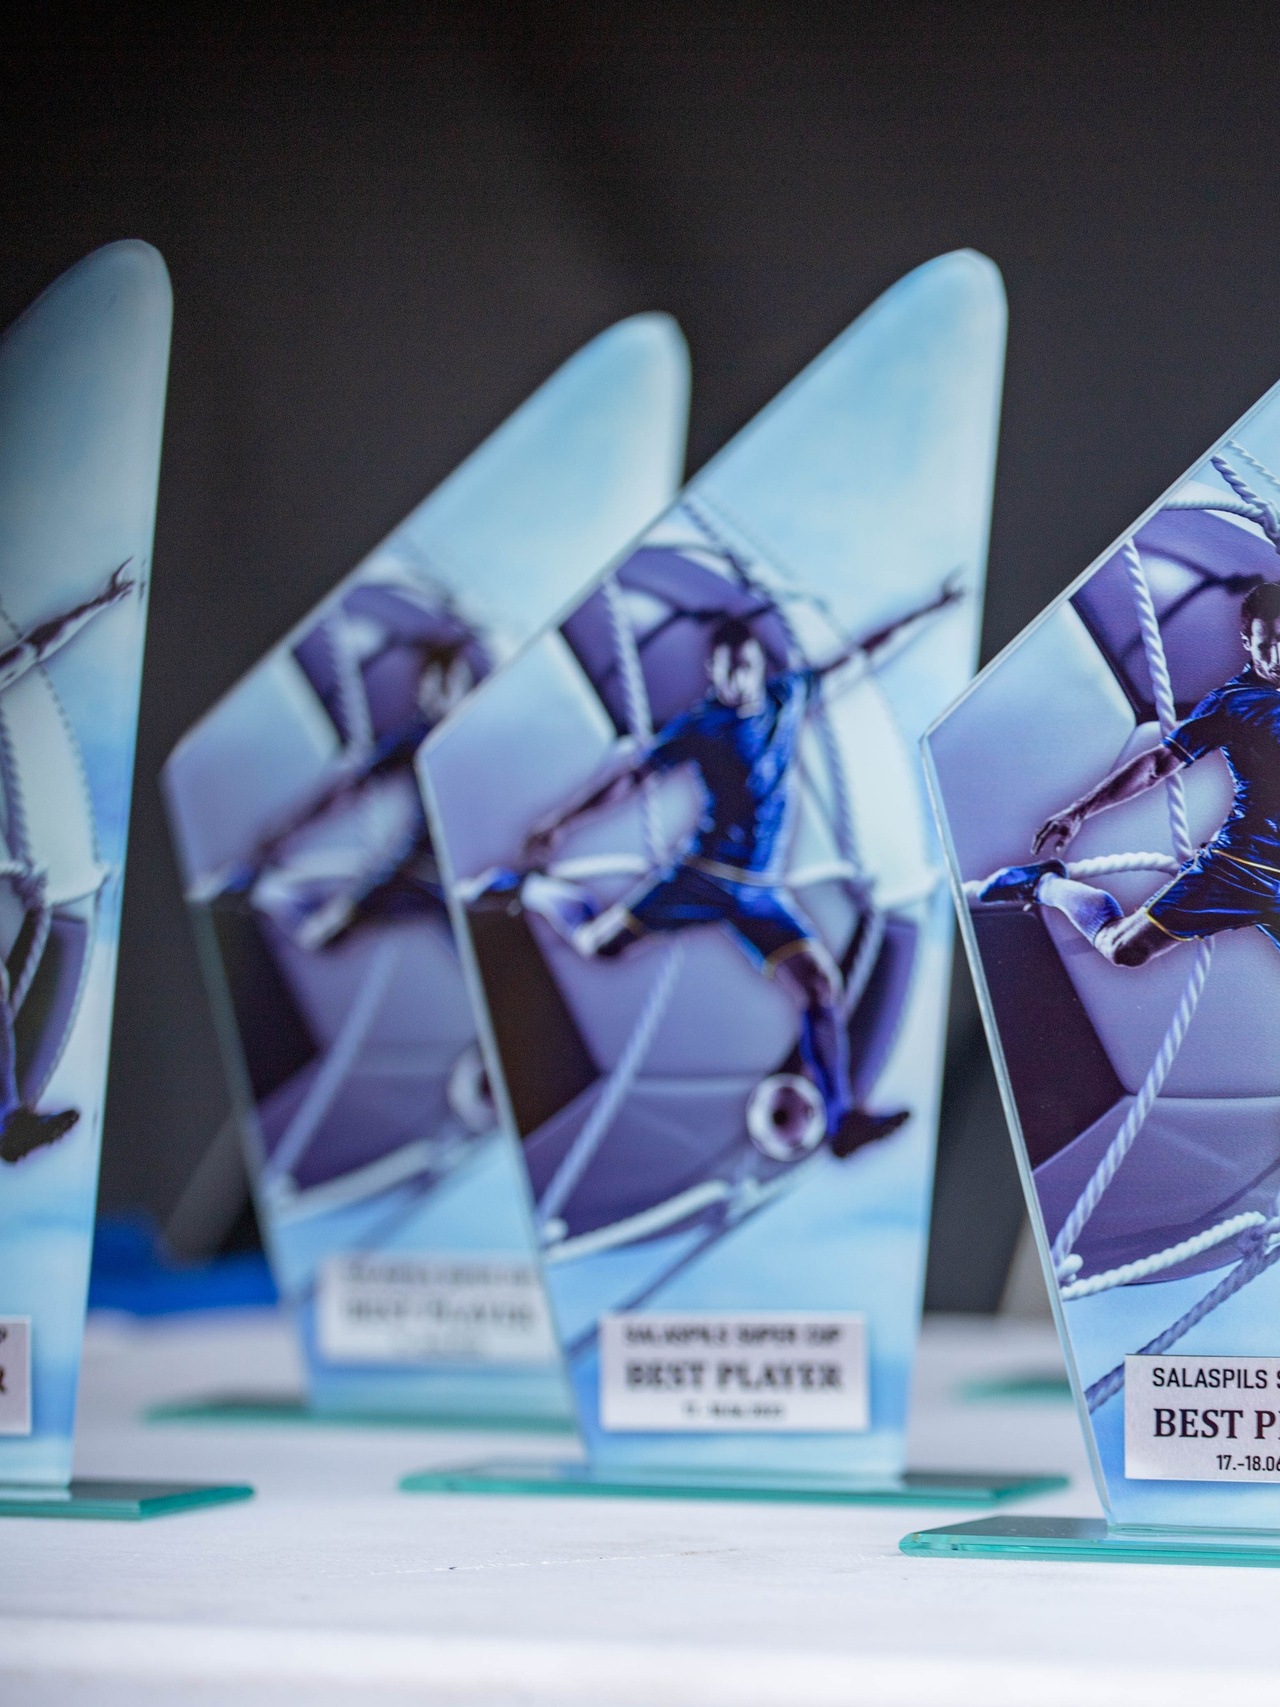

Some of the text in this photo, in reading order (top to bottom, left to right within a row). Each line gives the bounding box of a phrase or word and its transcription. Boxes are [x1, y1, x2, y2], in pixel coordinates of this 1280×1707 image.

[626, 1361, 843, 1391] BEST PLAYER
[1152, 1367, 1268, 1389] SALASPILS
[1153, 1408, 1244, 1440] BEST
